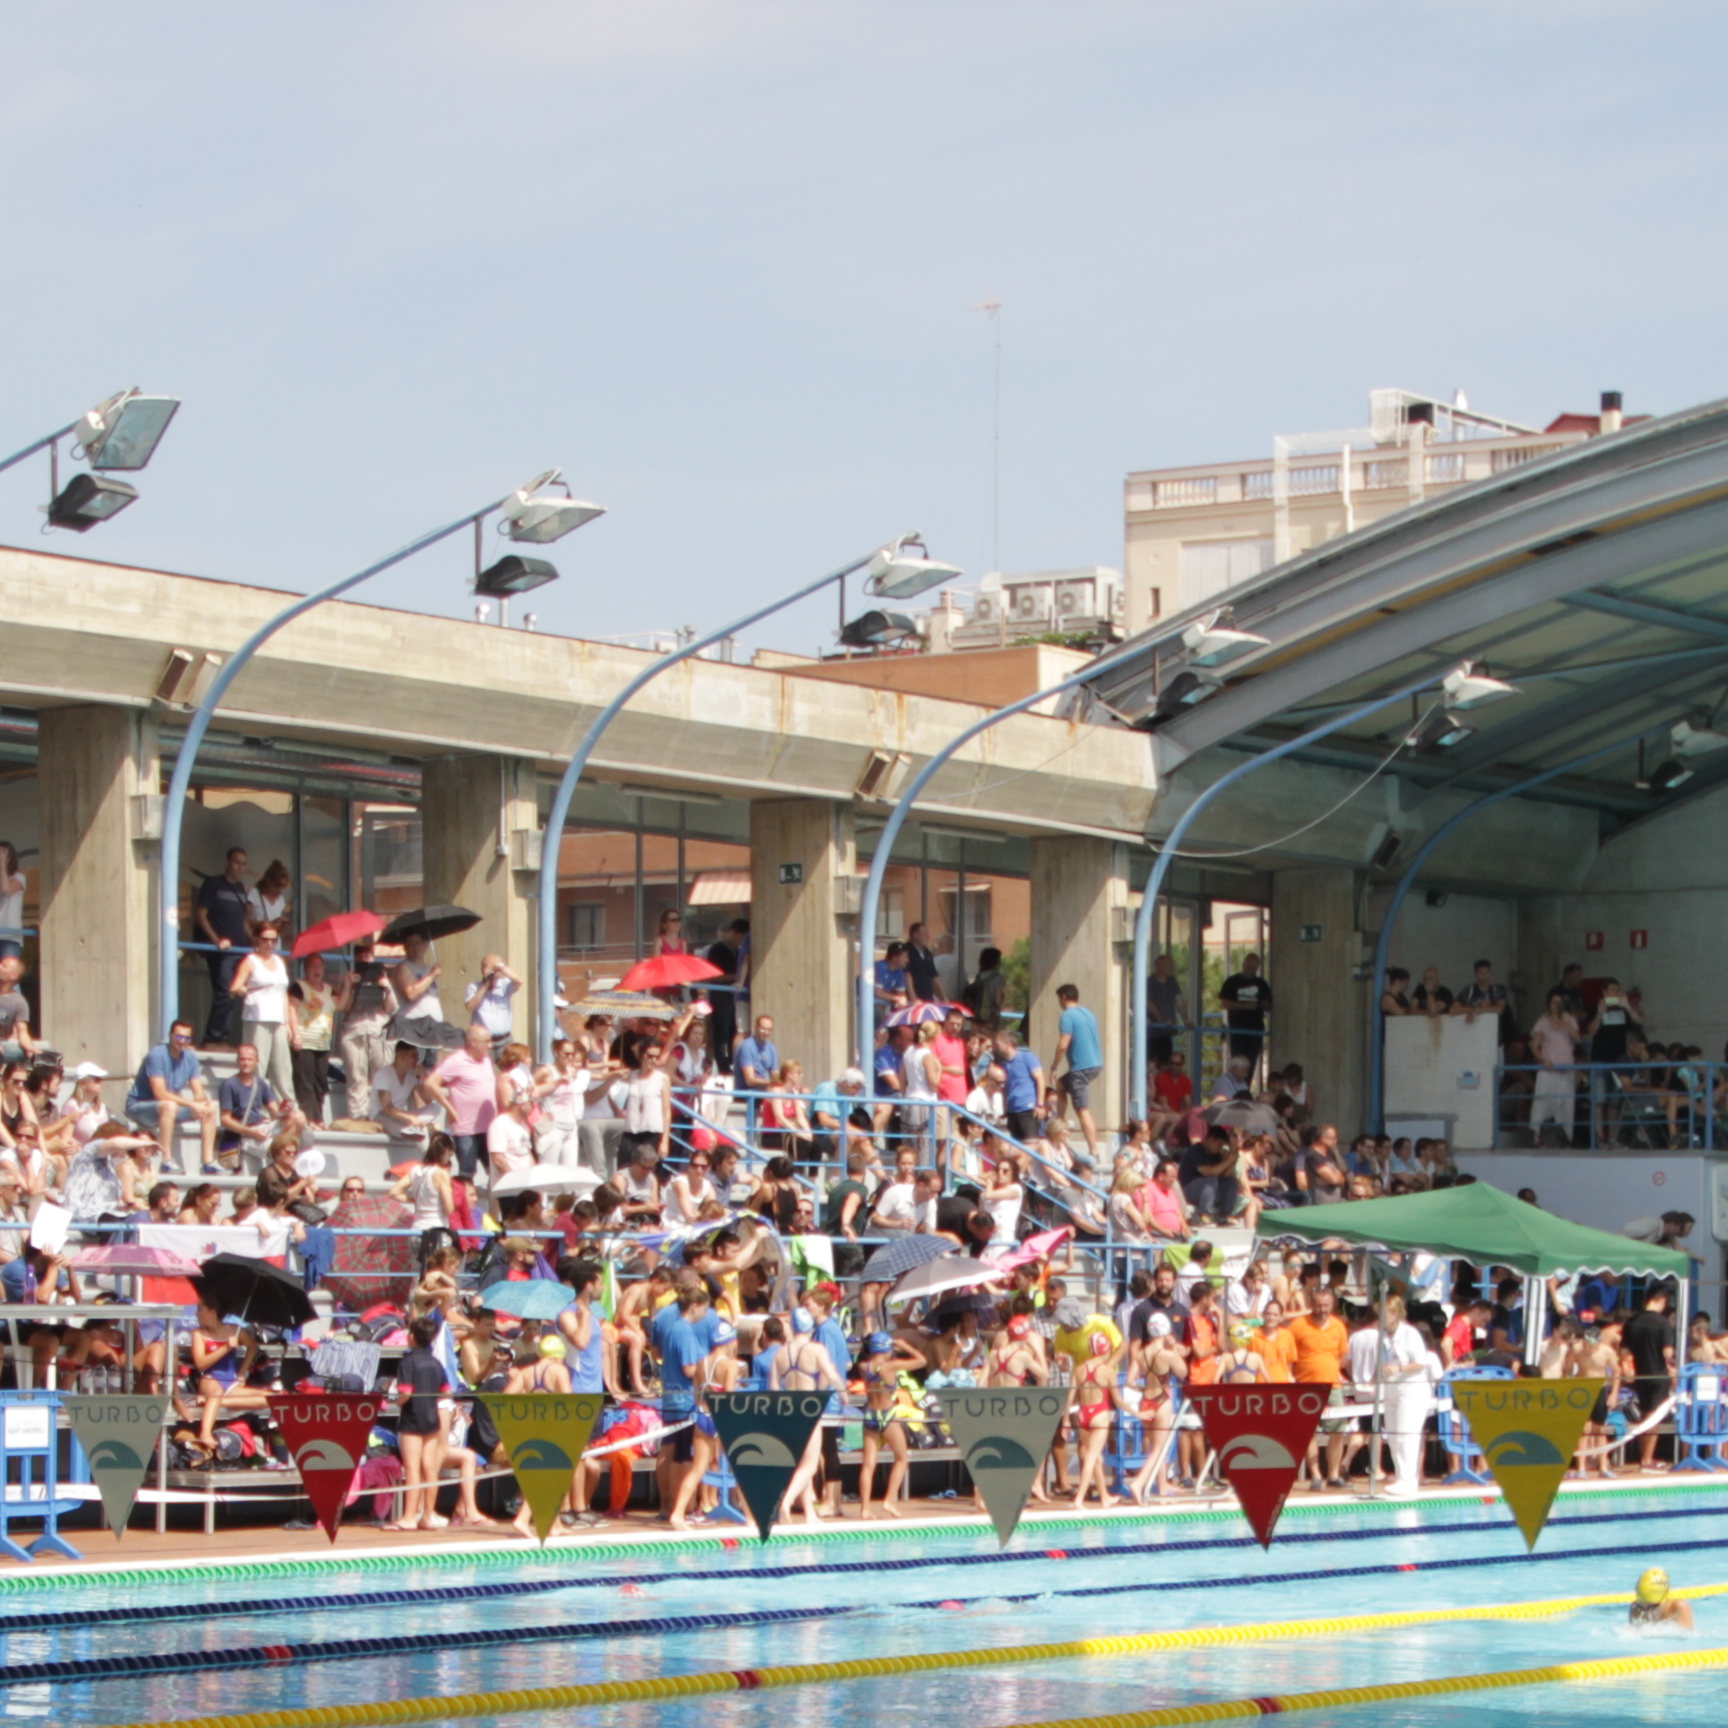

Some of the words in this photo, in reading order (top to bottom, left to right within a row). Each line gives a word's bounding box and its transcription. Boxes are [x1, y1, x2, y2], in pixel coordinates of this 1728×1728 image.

[709, 1394, 823, 1418] TURBO
[946, 1395, 1061, 1418] TURBO
[1197, 1392, 1322, 1417] TURBO
[1461, 1387, 1591, 1411] TURBO
[72, 1405, 163, 1422] TURBO
[274, 1402, 375, 1425] TURBO
[492, 1401, 596, 1422] TURBO
